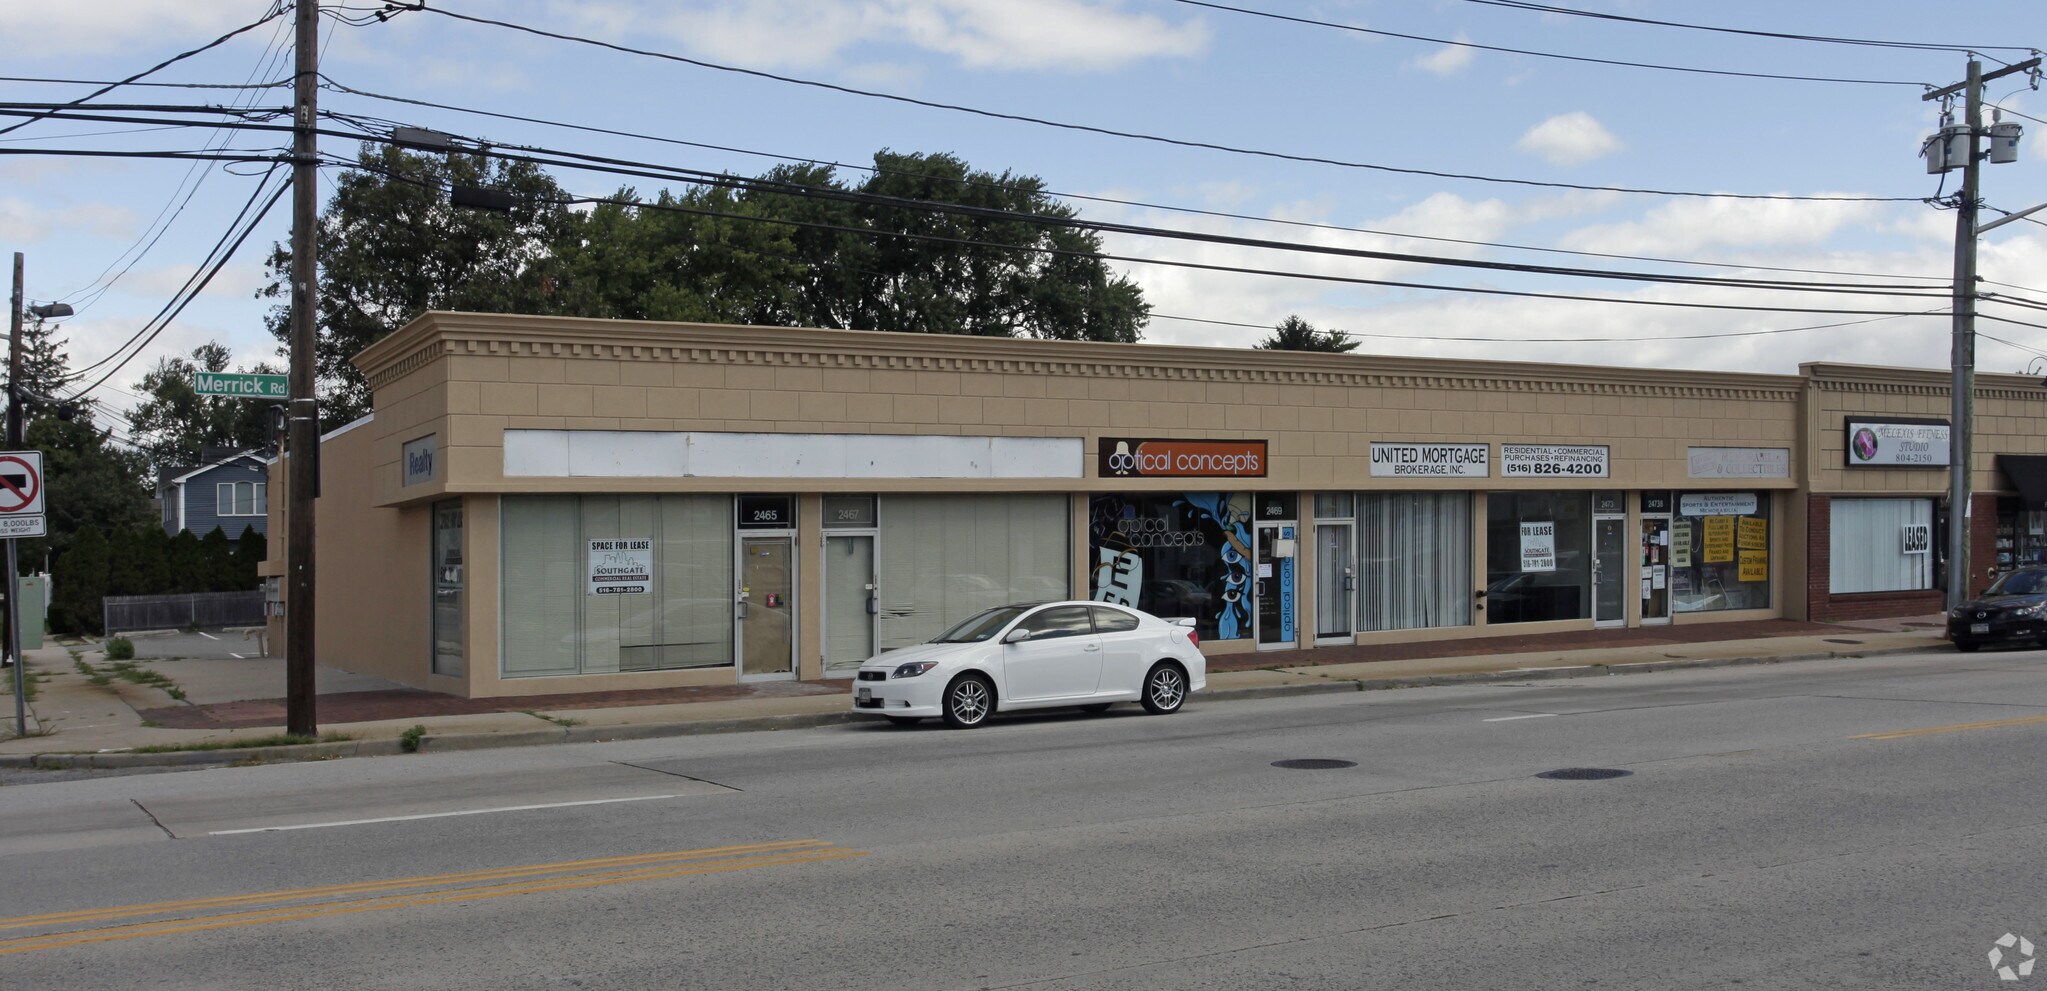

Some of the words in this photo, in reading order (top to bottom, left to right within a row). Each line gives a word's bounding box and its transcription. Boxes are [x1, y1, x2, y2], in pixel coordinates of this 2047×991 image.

[197, 374, 263, 394] Merrick
[270, 382, 285, 394] Rd
[1916, 428, 1949, 440] FITNESS
[1503, 447, 1553, 455] RESIDENTIAL
[1557, 448, 1605, 456] COMMERCIAL
[1898, 441, 1929, 452] STUDIO
[1372, 447, 1418, 463] UNITED
[1422, 447, 1486, 464] MORTGAGE
[1504, 454, 1550, 462] PURCHASES
[1554, 455, 1603, 463] REFINANCING
[1895, 453, 1932, 463] 804-2150
[409, 449, 433, 476] Realty
[1108, 450, 1171, 472] optical
[1176, 450, 1259, 474] concepts
[1394, 464, 1448, 475] BROKERAGE,
[1449, 465, 1466, 474] INC.
[1507, 464, 1531, 473] (516)
[1534, 463, 1602, 474] 826-4200
[1601, 500, 1614, 508] 2473
[754, 510, 777, 520] 2465
[838, 509, 859, 520] 2467
[1266, 507, 1282, 516] 2469
[1522, 526, 1531, 536] FOR
[1532, 526, 1552, 536] LEASE
[1130, 527, 1205, 553] concepts
[1904, 526, 1928, 552] LEASED
[592, 542, 613, 550] SPACE
[616, 541, 628, 550] FOR
[630, 540, 650, 550] LEASE
[1283, 592, 1291, 632] optical
